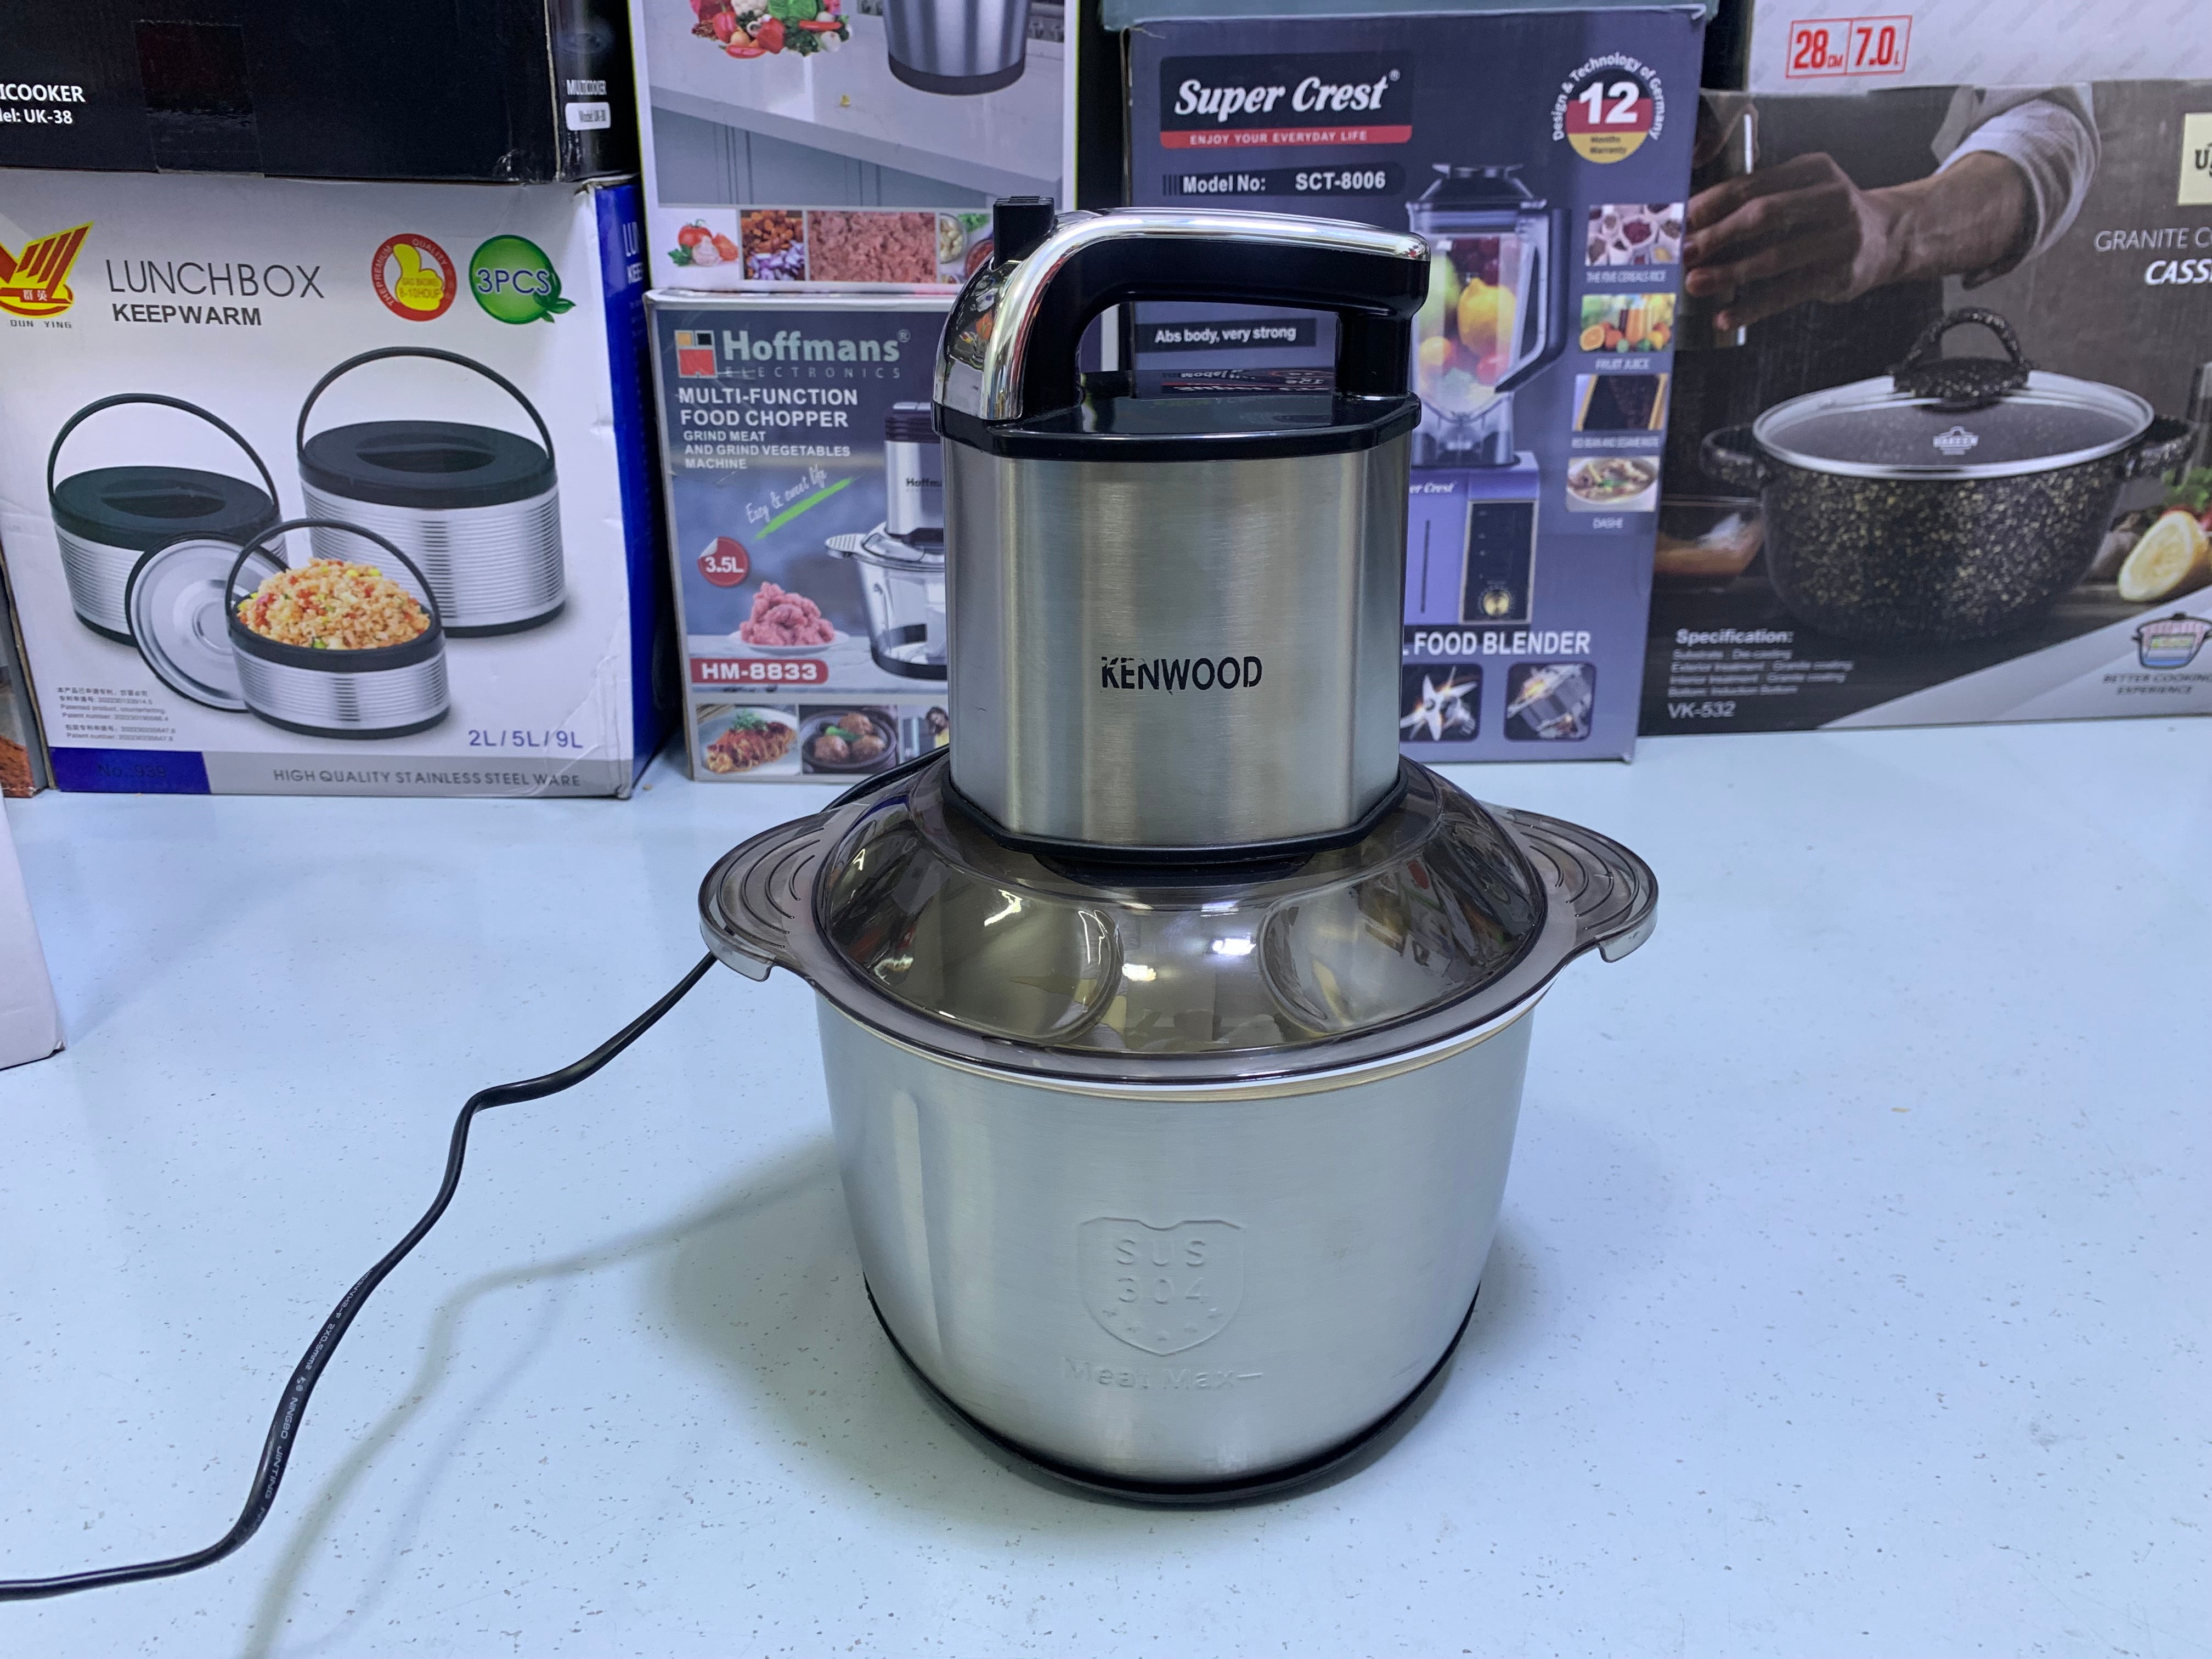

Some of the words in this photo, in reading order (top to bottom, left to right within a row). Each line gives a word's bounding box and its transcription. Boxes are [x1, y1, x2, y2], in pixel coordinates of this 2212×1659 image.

[0, 83, 86, 102] ICOOKER
[1175, 79, 1286, 122] Super
[1291, 75, 1388, 112] Crest
[1551, 94, 1568, 141] Design
[1561, 82, 1575, 94] &
[1568, 52, 1642, 82] Technology
[1640, 66, 1657, 81] of
[1649, 77, 1666, 141] Germany
[1579, 82, 1639, 125] 12
[24, 109, 73, 124] UK-38
[1190, 134, 1230, 145] ENJOY
[1235, 133, 1268, 144] YOUR
[1272, 131, 1336, 143] EVERYDAY
[1340, 130, 1367, 141] LIFE
[1183, 174, 1233, 193] Model
[1237, 174, 1266, 191] No:
[1295, 171, 1386, 190] SCT-8006
[2094, 228, 2190, 252] GRANITE
[2194, 227, 2212, 248] C
[412, 238, 448, 265] QUALITY
[106, 259, 325, 298] LUNCHBOX
[2145, 258, 2212, 285] CASS
[478, 269, 551, 295] 3PCS
[10, 319, 33, 328] DUN
[112, 303, 262, 326] KEEPWARM
[1155, 329, 1181, 344] Abs
[1183, 327, 1220, 345] body,
[1222, 328, 1250, 342] very
[1252, 326, 1296, 341] strong
[722, 330, 900, 362] Hoffmans
[725, 366, 901, 379] ELECTRONICS
[679, 388, 857, 406] MULTI-FUNCTION
[680, 410, 739, 426] FOOD
[745, 411, 849, 428] CHOPPER
[684, 431, 726, 441] GRIND
[729, 431, 766, 442] MEAT
[685, 444, 713, 455] AND
[715, 445, 759, 456] GRIND
[762, 445, 851, 457] VEGETABLES
[685, 458, 747, 470] MACHINE
[706, 556, 744, 573] 3.5L
[1414, 631, 1478, 655] FOOD
[1482, 630, 1591, 655] BLENDER
[1675, 628, 1794, 647] Specification:
[702, 663, 817, 681] HM-8833
[1101, 656, 1262, 690] KENWOOD
[2117, 685, 2193, 695] EXPERIENCE
[1668, 701, 1736, 719] VK-532
[274, 769, 315, 782] HIGH
[320, 770, 390, 783] QUALITY
[396, 771, 482, 785] STAINLESS
[484, 772, 529, 786] STEEL
[533, 774, 580, 787] WARE
[1116, 1238, 1206, 1268] SUS
[1116, 1277, 1206, 1305] 304
[280, 1397, 298, 1440] NINGBO
[264, 1445, 282, 1499] JINTING
